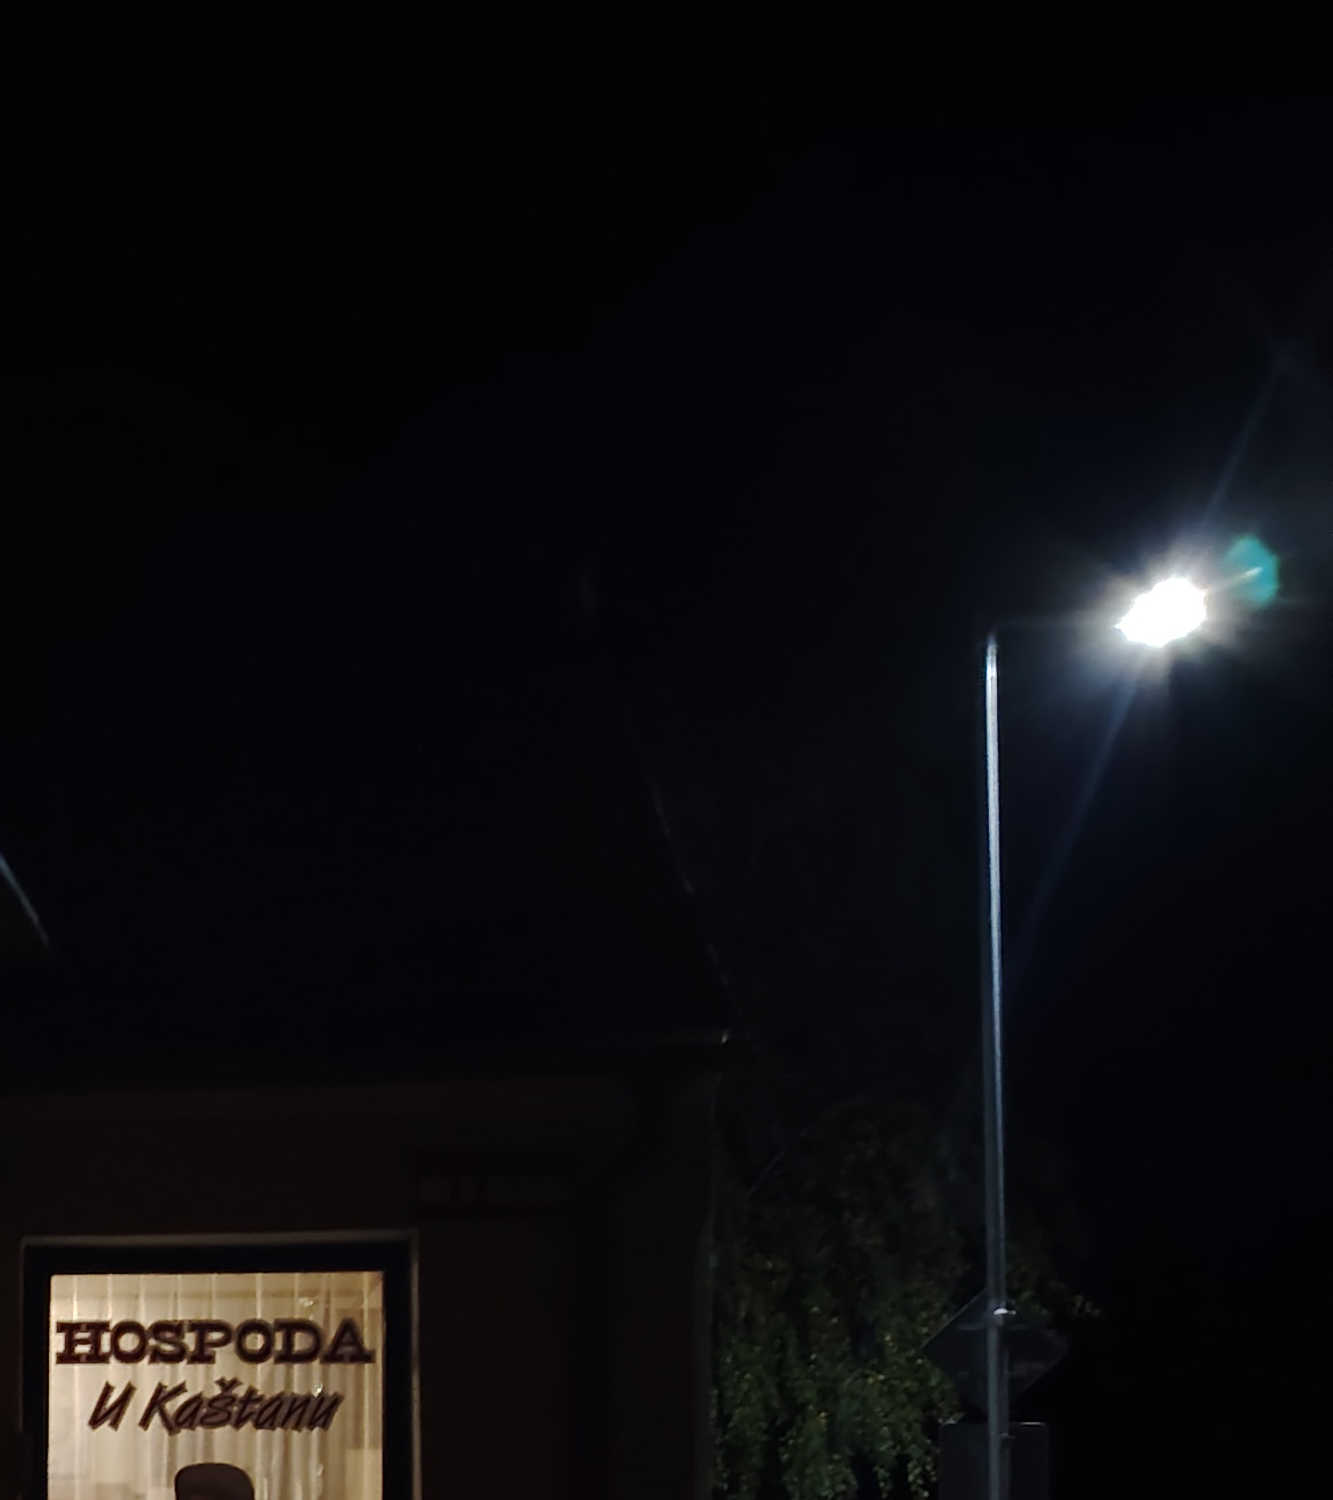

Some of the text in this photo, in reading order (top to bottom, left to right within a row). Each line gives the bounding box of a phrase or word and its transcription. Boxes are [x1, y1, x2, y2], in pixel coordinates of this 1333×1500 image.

[56, 1319, 375, 1364] HOSPODA
[88, 1377, 344, 1436] U Kaštanu
